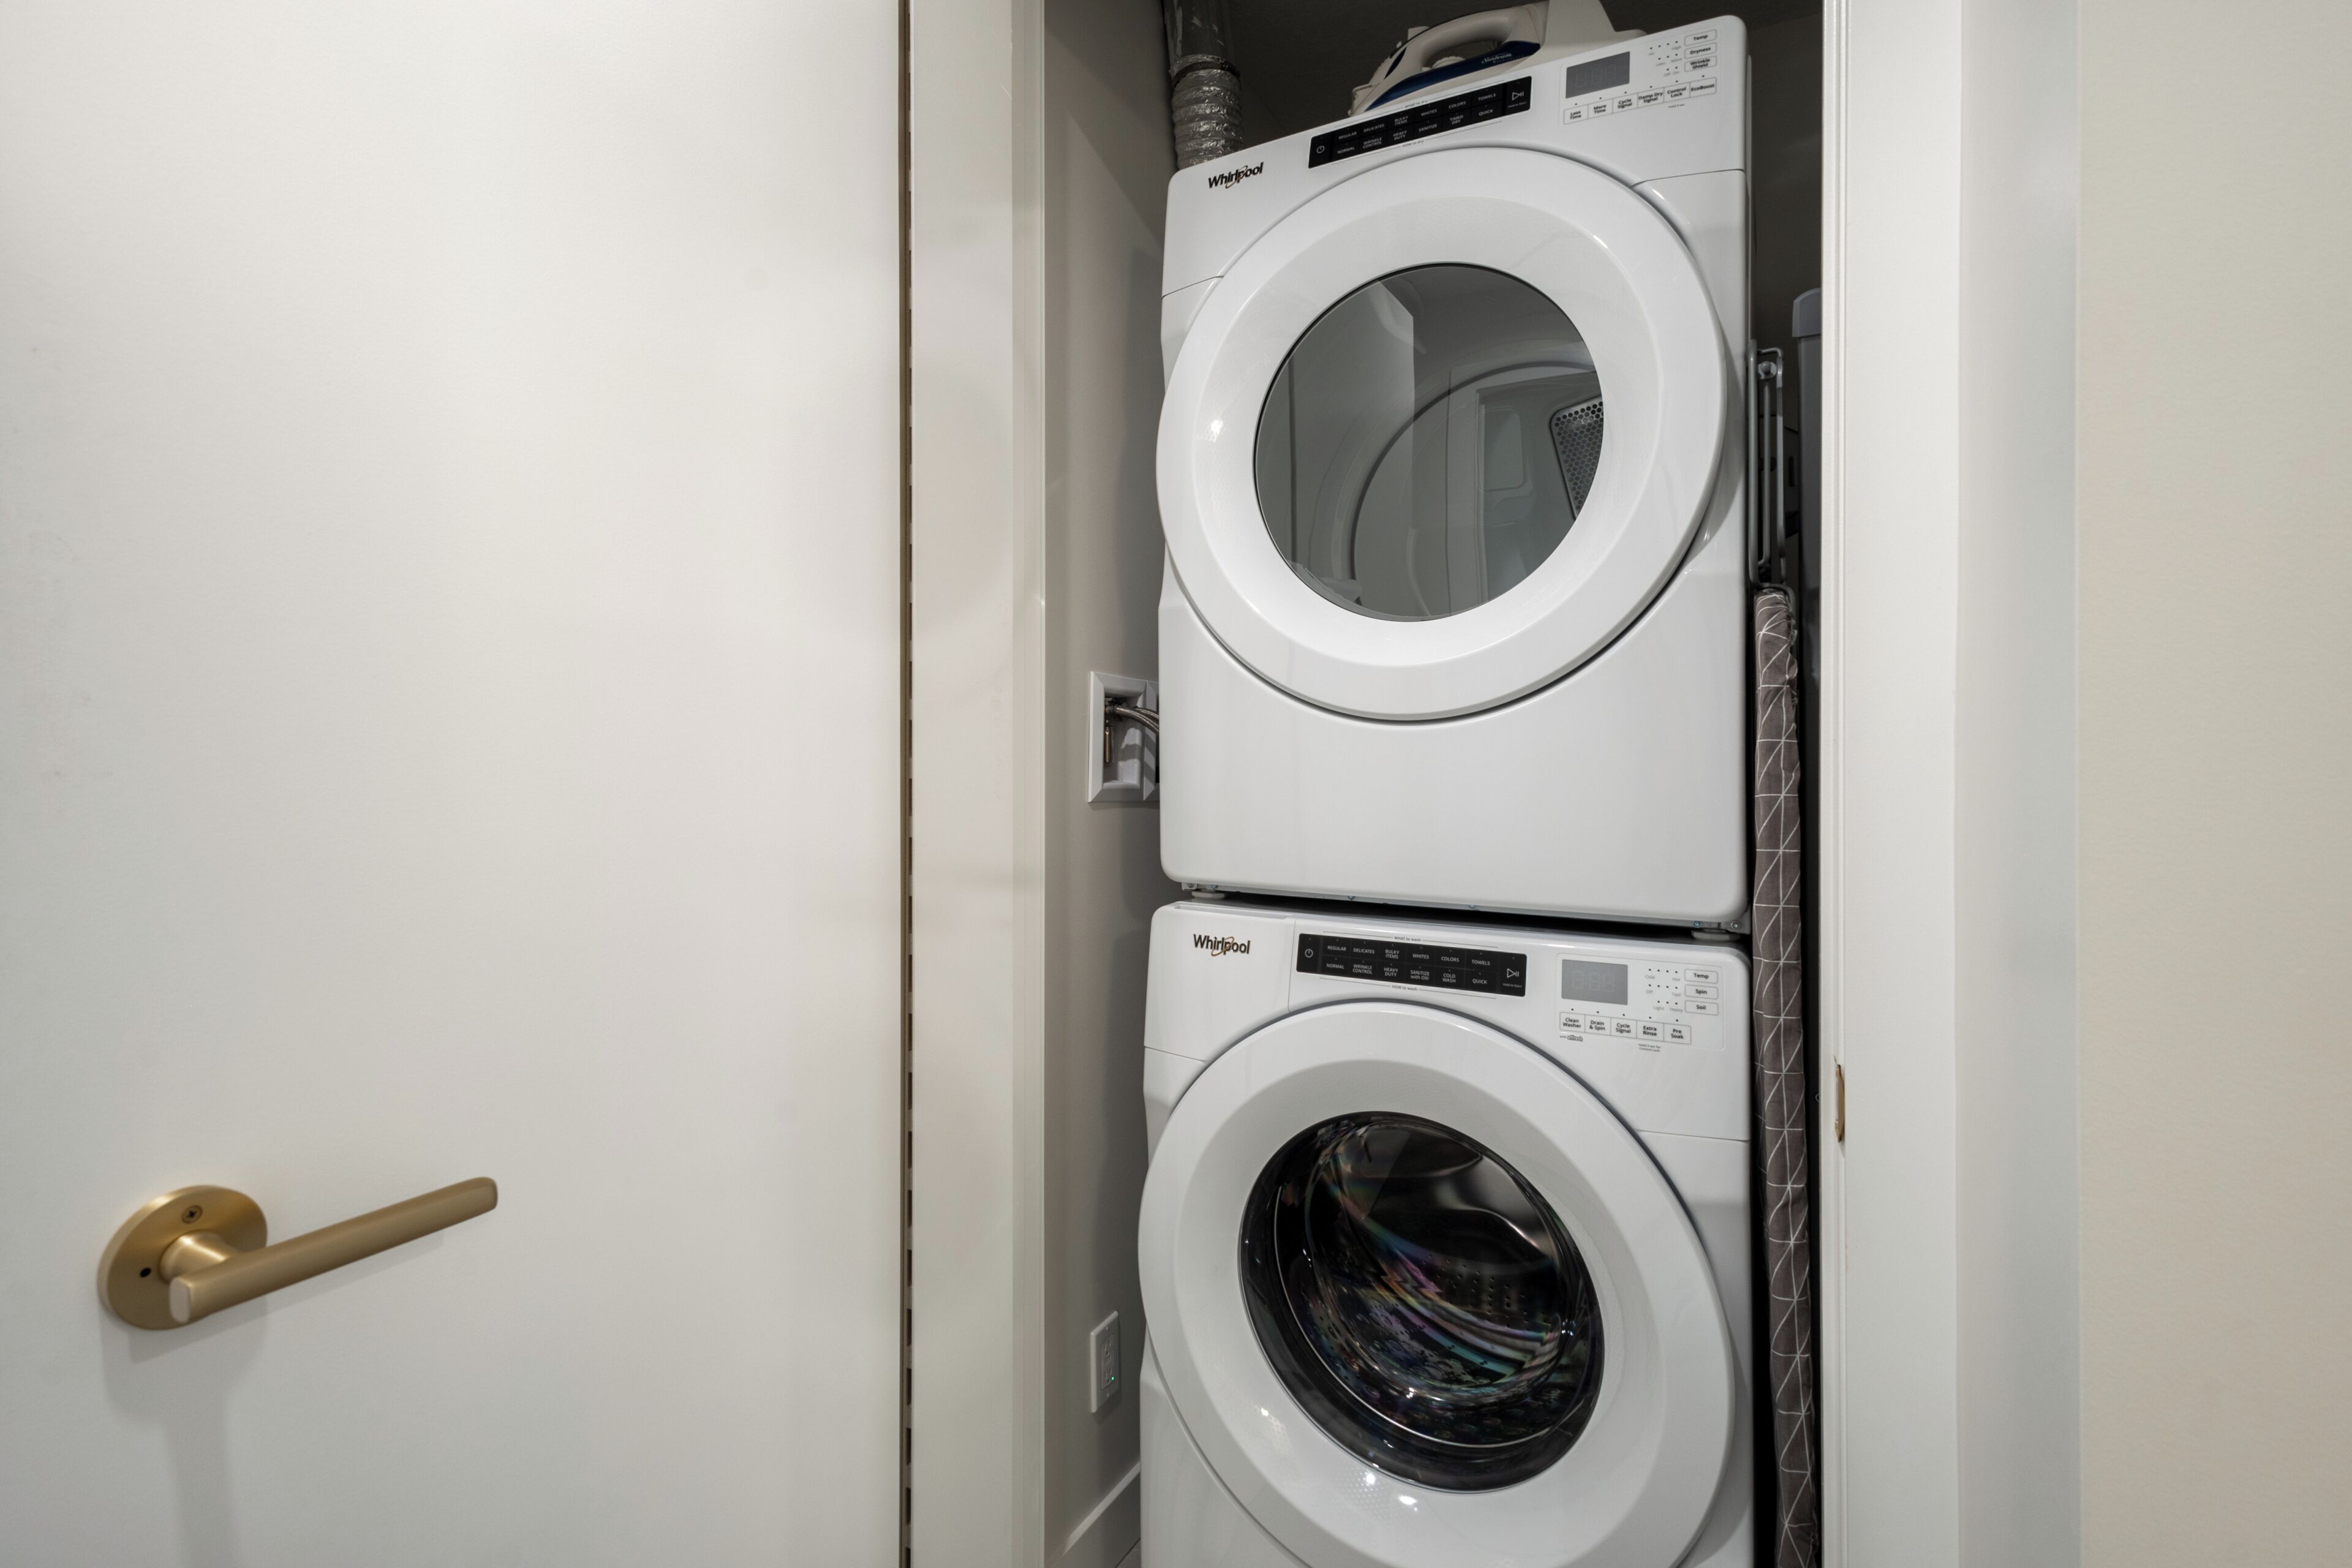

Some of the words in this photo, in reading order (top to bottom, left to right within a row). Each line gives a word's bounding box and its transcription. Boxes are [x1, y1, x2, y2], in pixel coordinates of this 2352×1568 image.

[1363, 124, 1385, 132] DELICATES
[1208, 162, 1264, 189] Whirlpool
[1193, 933, 1251, 955] Whirlpool
